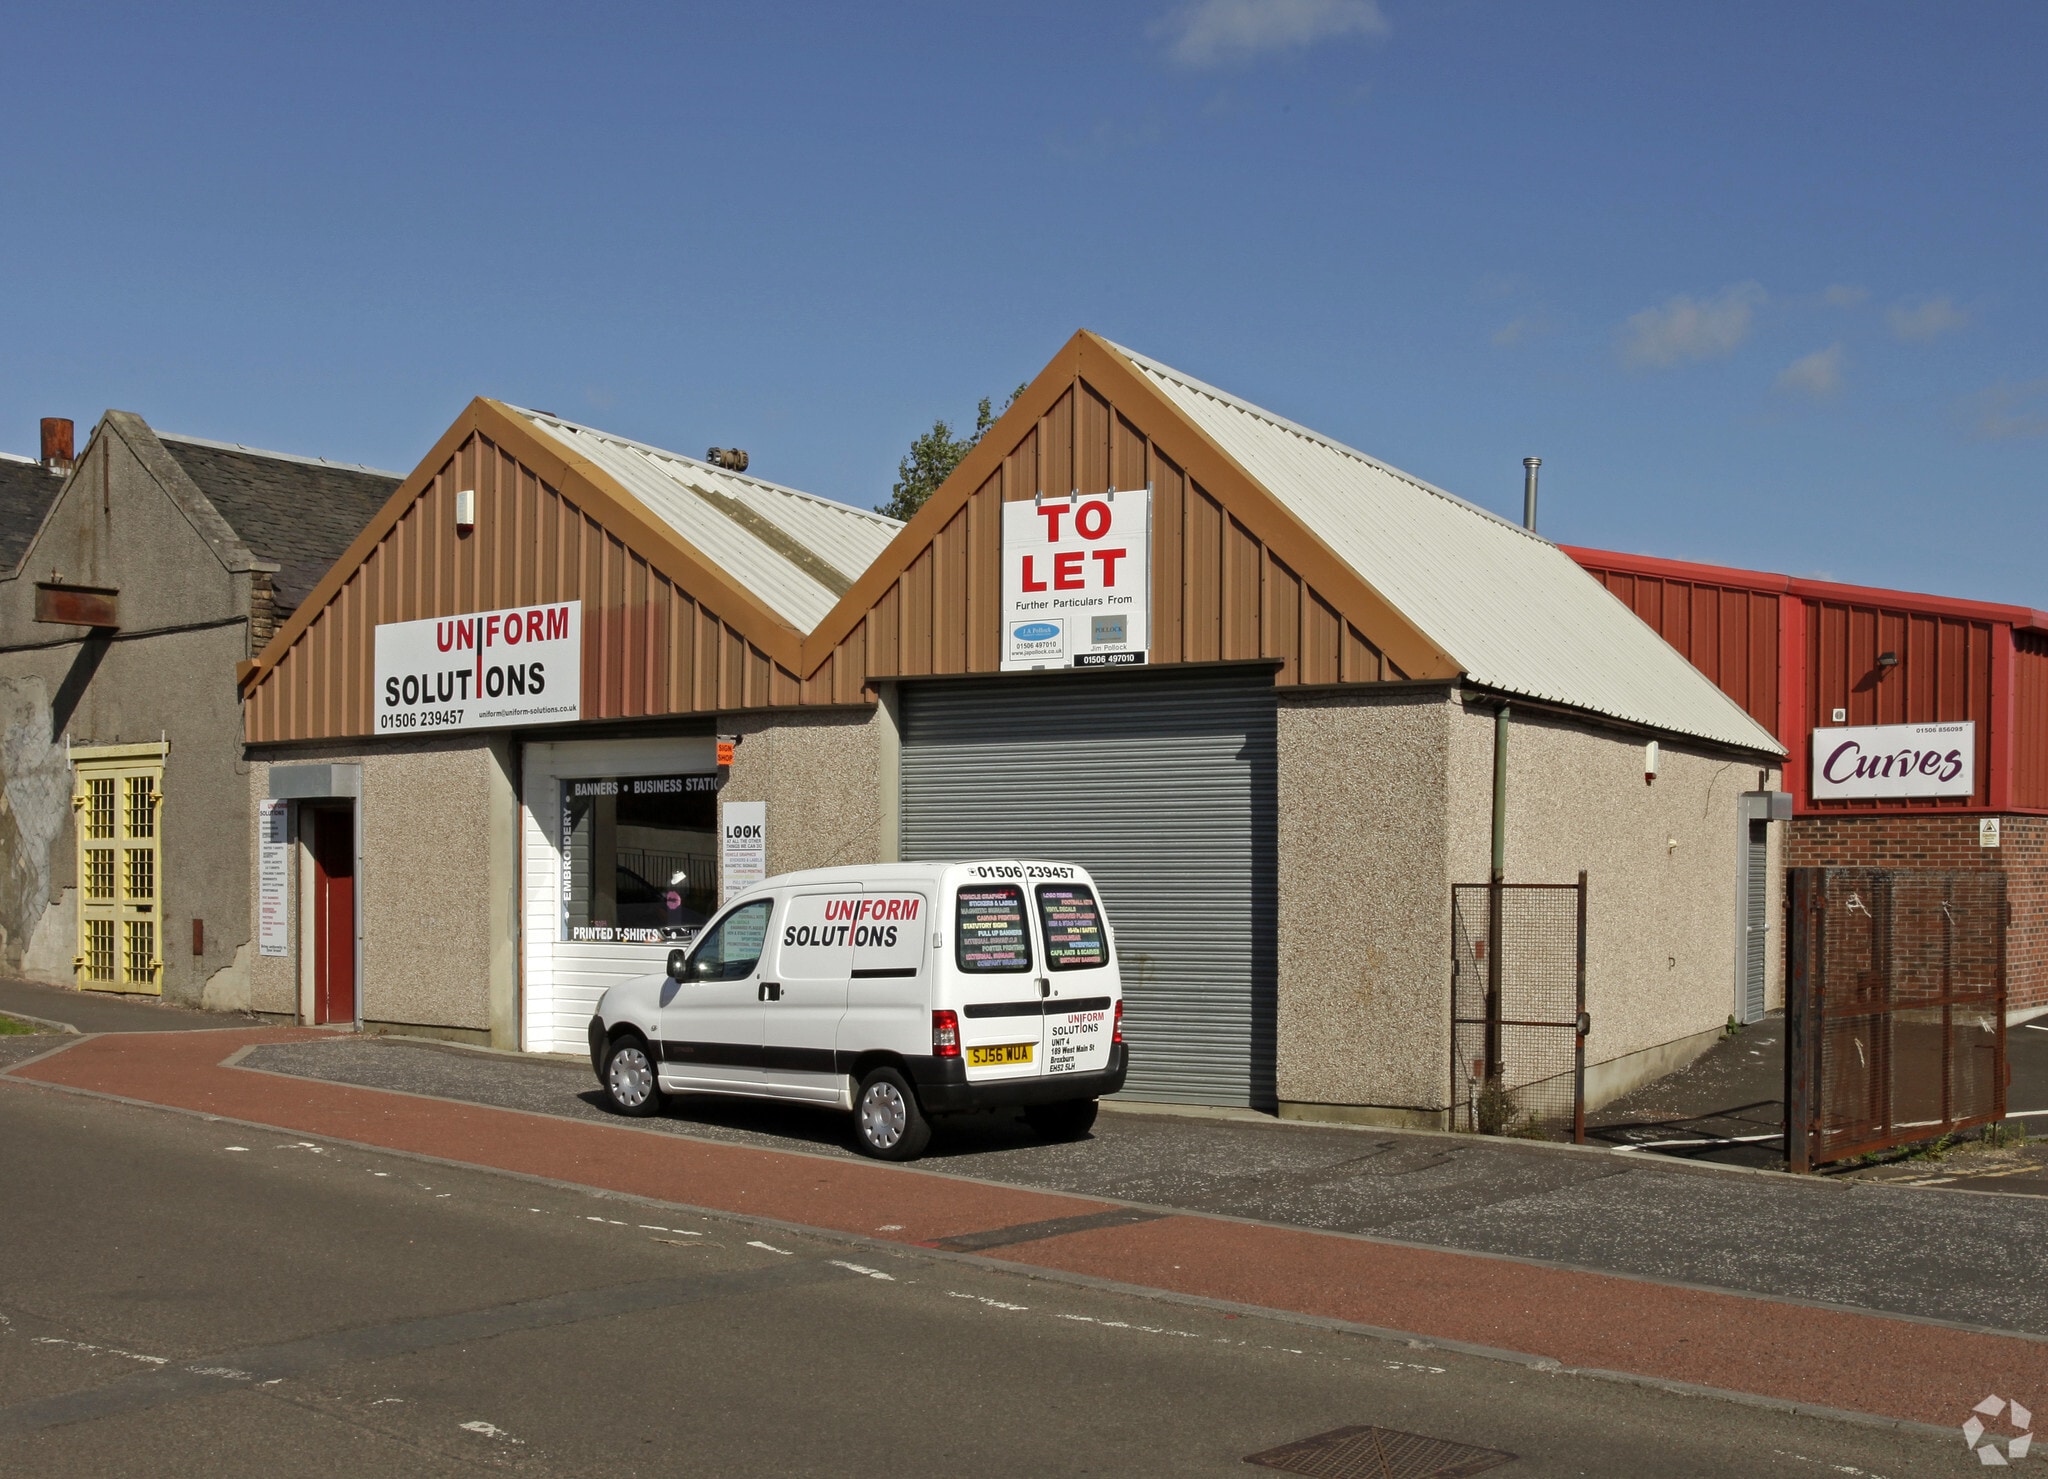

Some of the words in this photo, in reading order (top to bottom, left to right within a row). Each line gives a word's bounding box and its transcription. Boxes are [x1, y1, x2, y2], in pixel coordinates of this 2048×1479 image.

[1037, 500, 1112, 543] TO
[1022, 548, 1127, 593] LET
[1016, 601, 1049, 611] Further
[1053, 597, 1104, 608] Particulars
[1108, 595, 1133, 604] From
[436, 606, 569, 654] UNIFORM
[1035, 641, 1057, 649] 497010
[1103, 643, 1127, 651] Pollock
[1084, 655, 1106, 664] 01506
[1108, 653, 1135, 663] 497010
[384, 661, 545, 708] SOLUTIONS
[479, 703, 577, 718] uniform@uniform-solutions.co.uk
[380, 712, 417, 729] 01506
[420, 709, 464, 727] 239457
[1823, 740, 1963, 784] Curves
[574, 782, 619, 796] BANNERS
[633, 778, 683, 793] BUSINESS
[726, 825, 761, 838] LOOK
[563, 807, 572, 901] EMBROIDERY
[977, 866, 1023, 878] 01506
[1026, 866, 1074, 878] 239457
[824, 899, 920, 921] UNIFORM
[573, 926, 614, 940] PRINTED
[616, 927, 659, 942] T-SHIRTS
[783, 925, 898, 947] SOLUTIONS
[1067, 1012, 1105, 1024] UNIFORM
[1052, 1023, 1099, 1036] SOLUTIONS
[1051, 1038, 1065, 1046] UNIT
[1066, 1037, 1070, 1045] 4
[1051, 1047, 1061, 1055] 189
[1062, 1046, 1075, 1054] West
[1076, 1044, 1088, 1052] Main
[1089, 1043, 1095, 1051] St
[973, 1048, 1003, 1064] SJ56
[1006, 1047, 1028, 1061] WUA
[1050, 1055, 1075, 1064] Broxburn
[1049, 1064, 1064, 1072] EH52
[1065, 1062, 1076, 1071] 5LH
